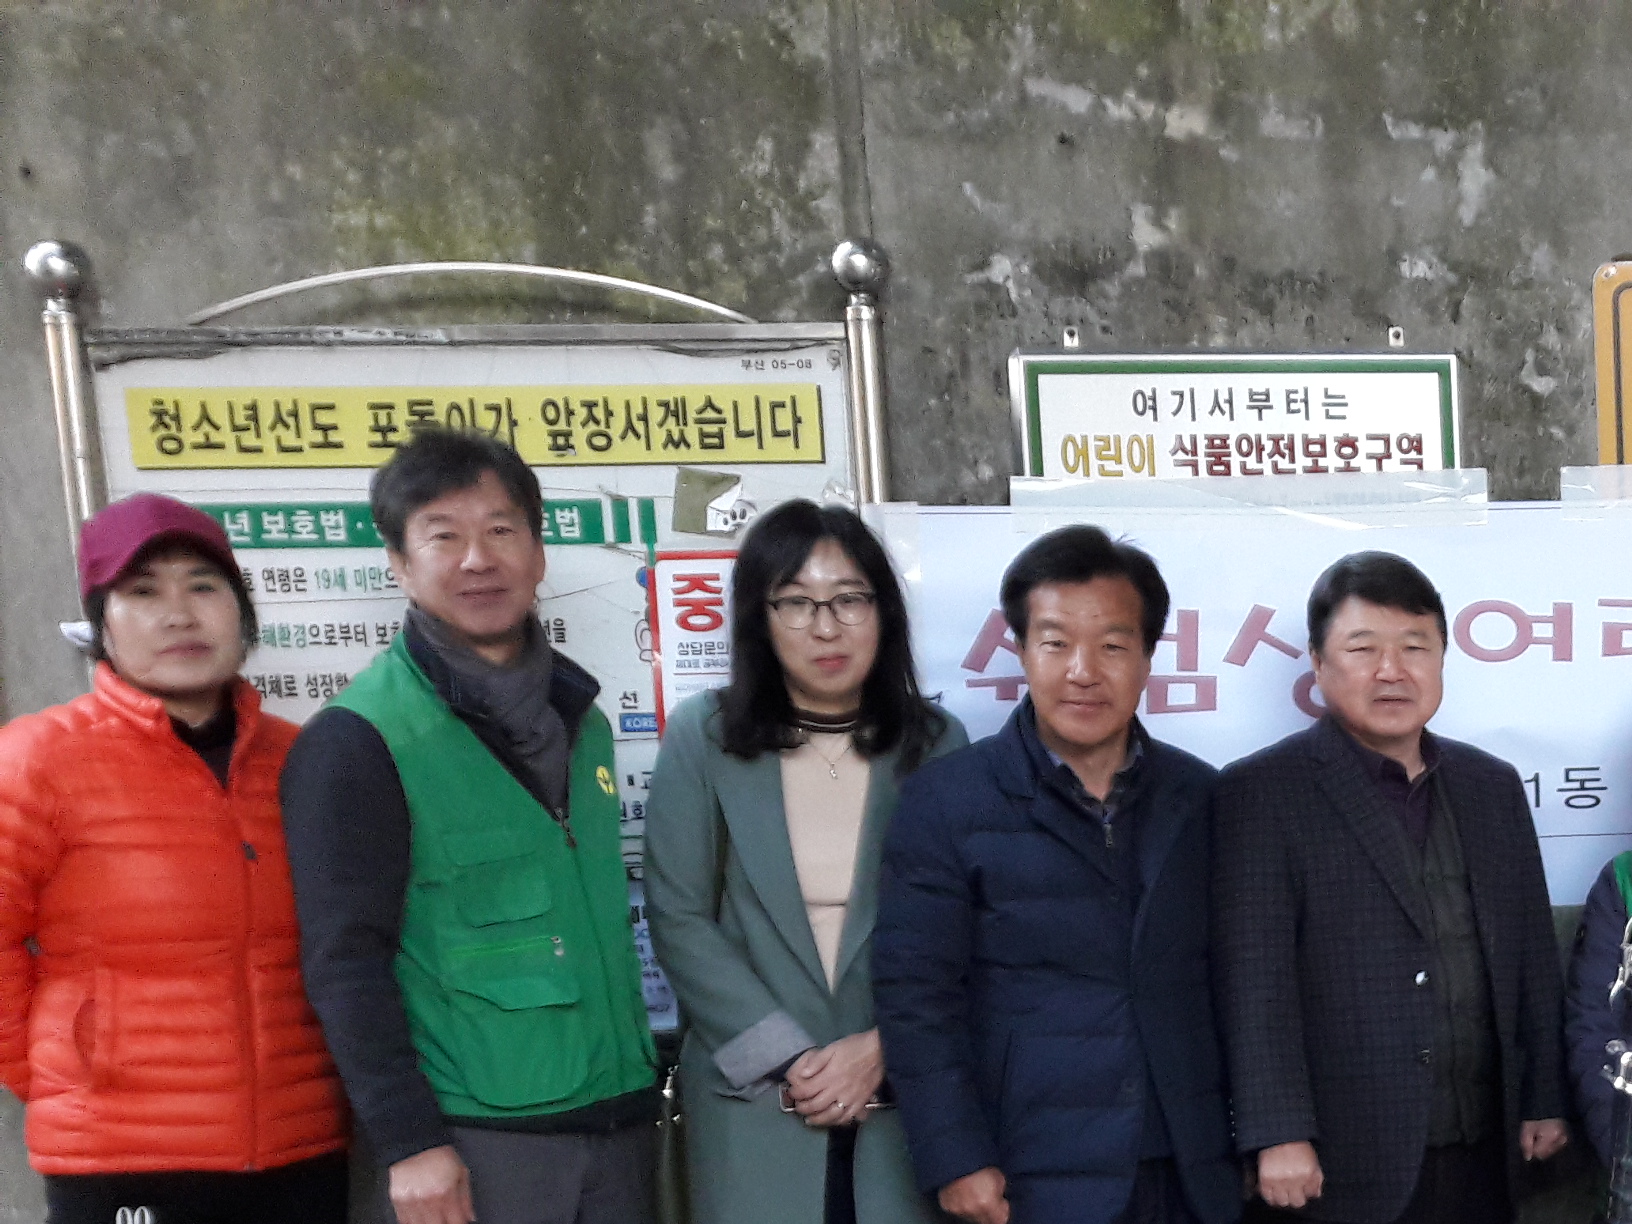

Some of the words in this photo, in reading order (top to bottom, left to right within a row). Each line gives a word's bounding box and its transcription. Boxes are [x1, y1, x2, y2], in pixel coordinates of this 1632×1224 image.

[1131, 385, 1349, 423] 여기서부터는
[148, 397, 345, 456] 청소년선도
[540, 393, 803, 458] 앞장서겠습니다
[1060, 433, 1157, 478] 어린이
[1168, 432, 1424, 478] 식품안전보호구역
[262, 566, 308, 593] 연령은
